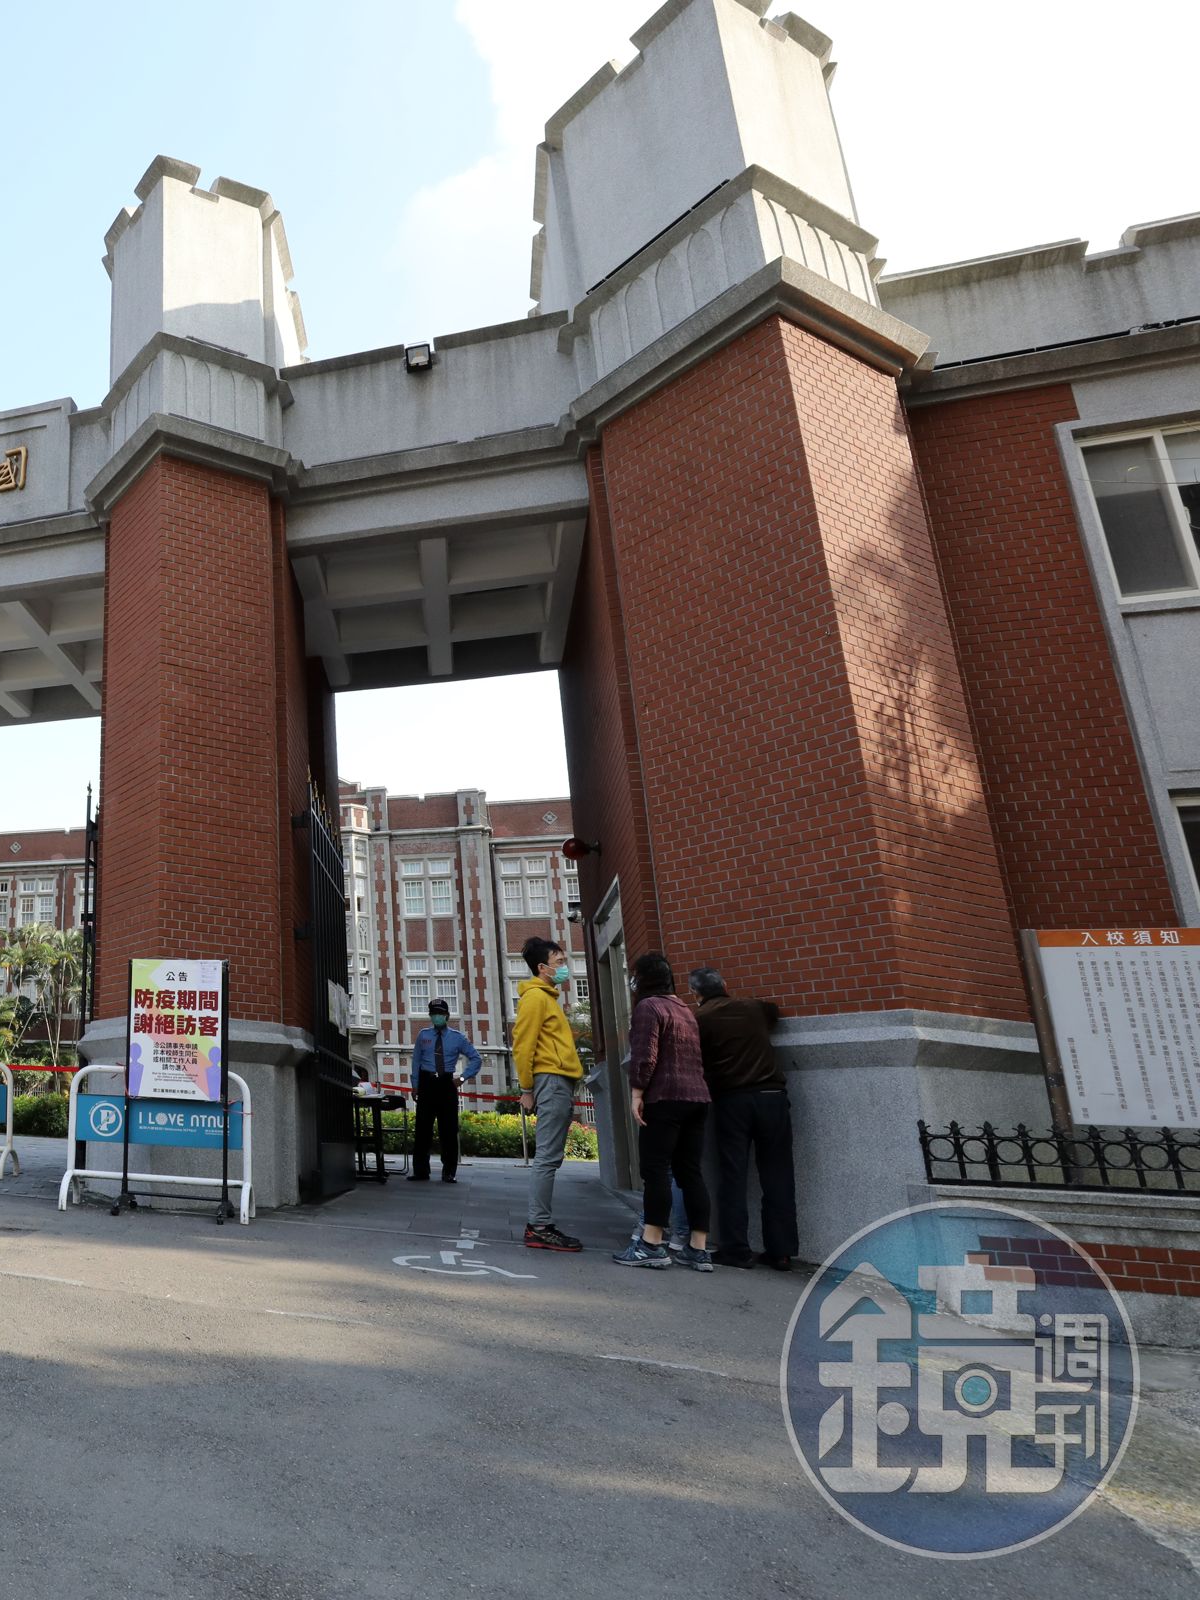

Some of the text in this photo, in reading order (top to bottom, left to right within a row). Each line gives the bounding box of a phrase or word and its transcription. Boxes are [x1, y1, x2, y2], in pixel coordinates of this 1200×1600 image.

[1081, 930, 1180, 945] 入校須知
[165, 971, 188, 982] 公告
[134, 988, 219, 1011] 防疫期間
[133, 1013, 219, 1037] 謝絕訪客
[162, 1064, 188, 1072] 請勿進入
[138, 1111, 143, 1125] I
[148, 1112, 184, 1126] LOVE
